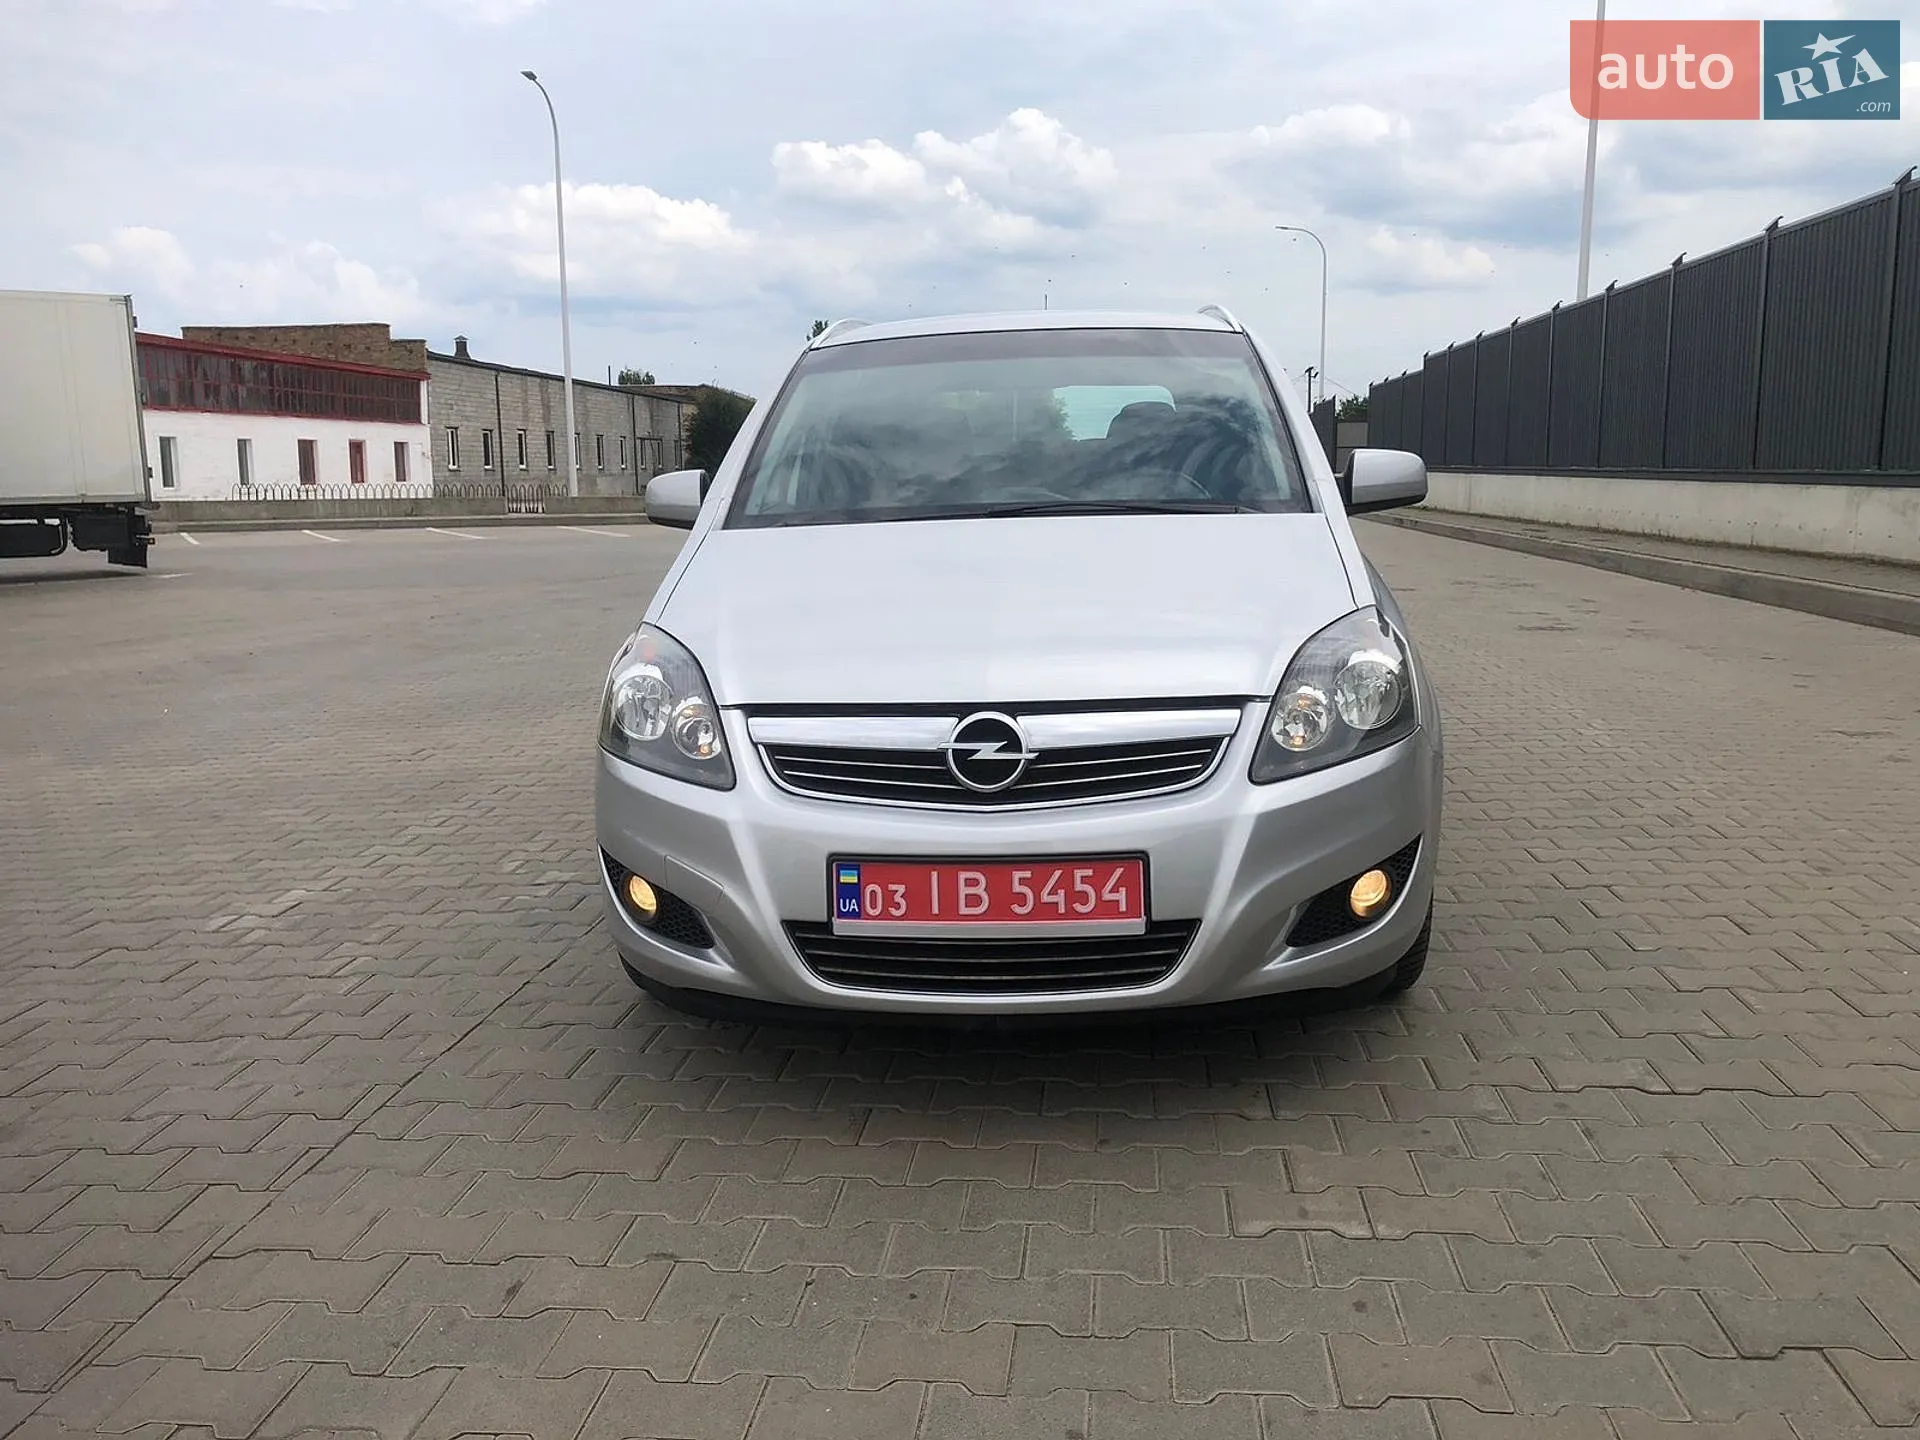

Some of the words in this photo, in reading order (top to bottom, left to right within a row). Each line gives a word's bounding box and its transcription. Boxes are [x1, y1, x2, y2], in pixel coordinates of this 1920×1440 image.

[839, 898, 860, 913] UA
[864, 883, 908, 917] 03
[930, 870, 990, 916] IB
[1010, 867, 1128, 916] 5454
